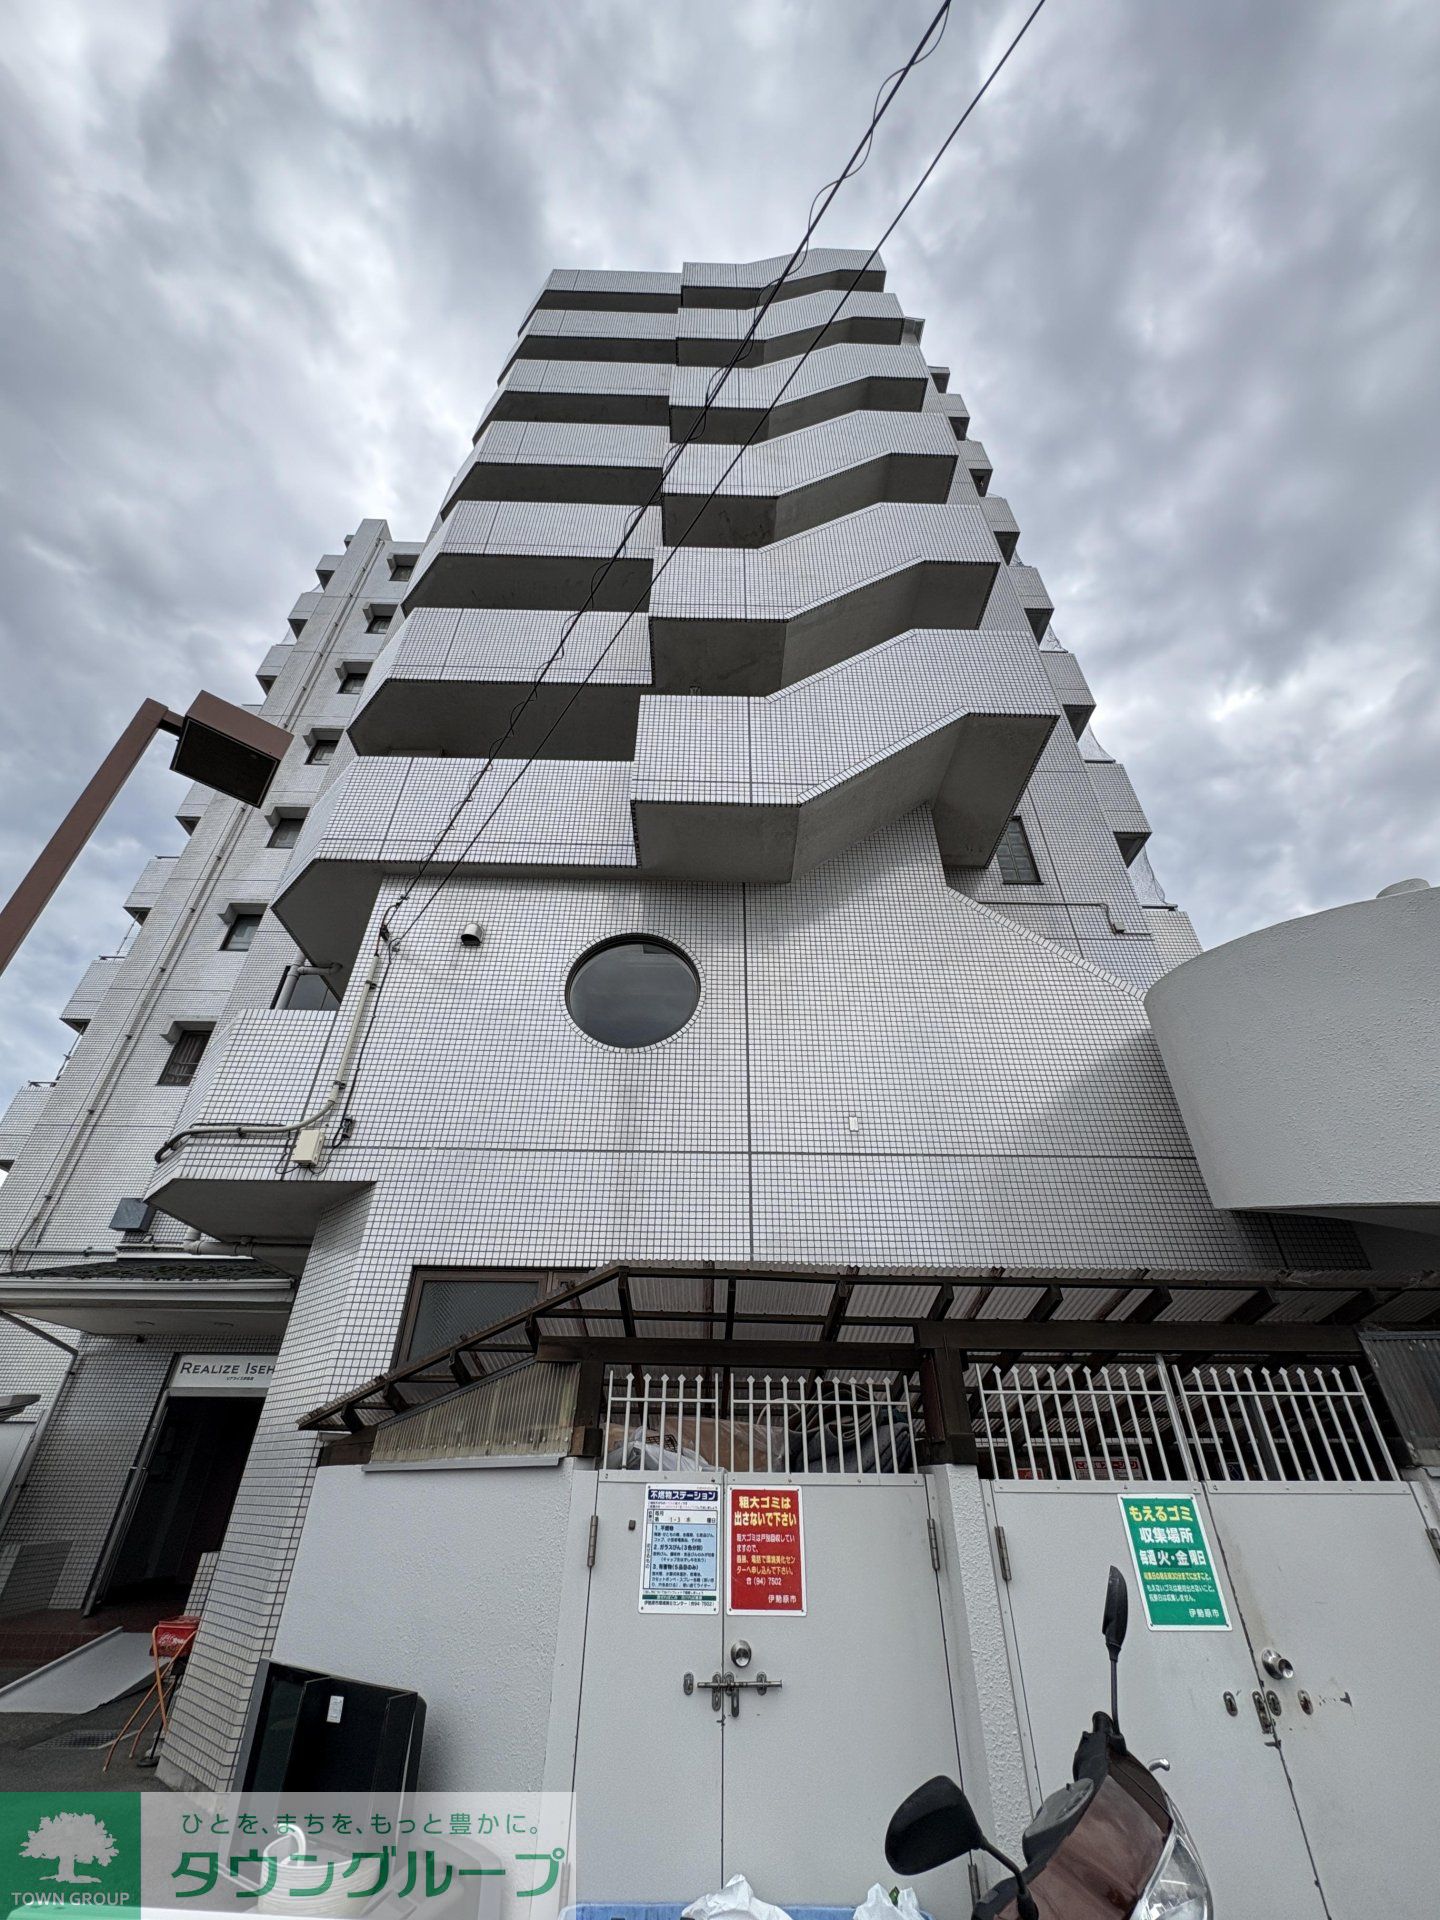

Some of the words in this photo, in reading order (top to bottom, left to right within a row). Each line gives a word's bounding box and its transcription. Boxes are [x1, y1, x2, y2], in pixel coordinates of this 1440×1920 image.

[180, 1362, 240, 1374] REALIZE
[650, 1491, 716, 1500] 不燃物ステーション
[739, 1496, 792, 1509] 粗大ゴミは
[734, 1511, 797, 1526] 出さないで下さい
[1129, 1505, 1193, 1522] もえるゴミ
[1139, 1527, 1194, 1544] 収集場所
[1139, 1549, 1207, 1567] 毎週火・金曜日
[768, 1577, 783, 1586] 7502
[768, 1594, 797, 1604] 伊勢原市
[1188, 1608, 1220, 1618] 伊勢原市
